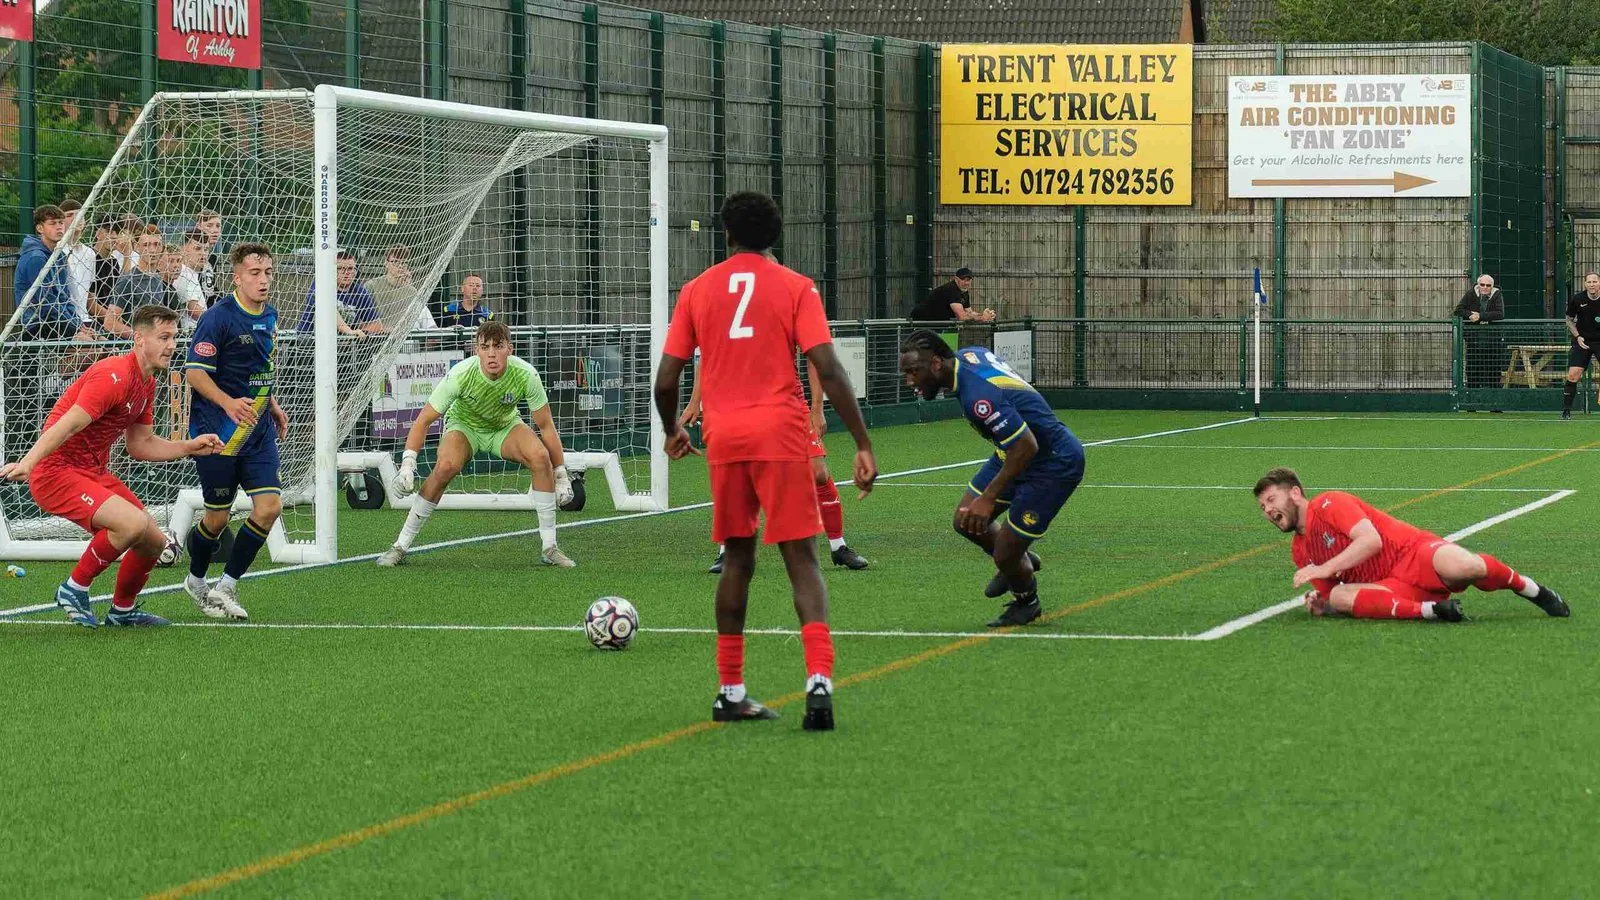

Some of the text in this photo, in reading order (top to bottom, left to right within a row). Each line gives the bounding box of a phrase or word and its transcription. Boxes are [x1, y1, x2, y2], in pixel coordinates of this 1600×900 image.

[185, 35, 236, 63] Of Ashby
[957, 53, 1177, 84] TRENT VALLEY
[975, 92, 1157, 122] ELECTRICAL
[1289, 83, 1406, 103] THE ABEY
[1240, 105, 1456, 127] AIR CONDITIONING
[994, 128, 1138, 157] SERVICES
[1233, 153, 1464, 168] Get your Alcoholic Refreshments here
[959, 167, 1175, 195] TEL: 01724 782356
[728, 271, 756, 340] 2
[80, 493, 95, 506] 5
